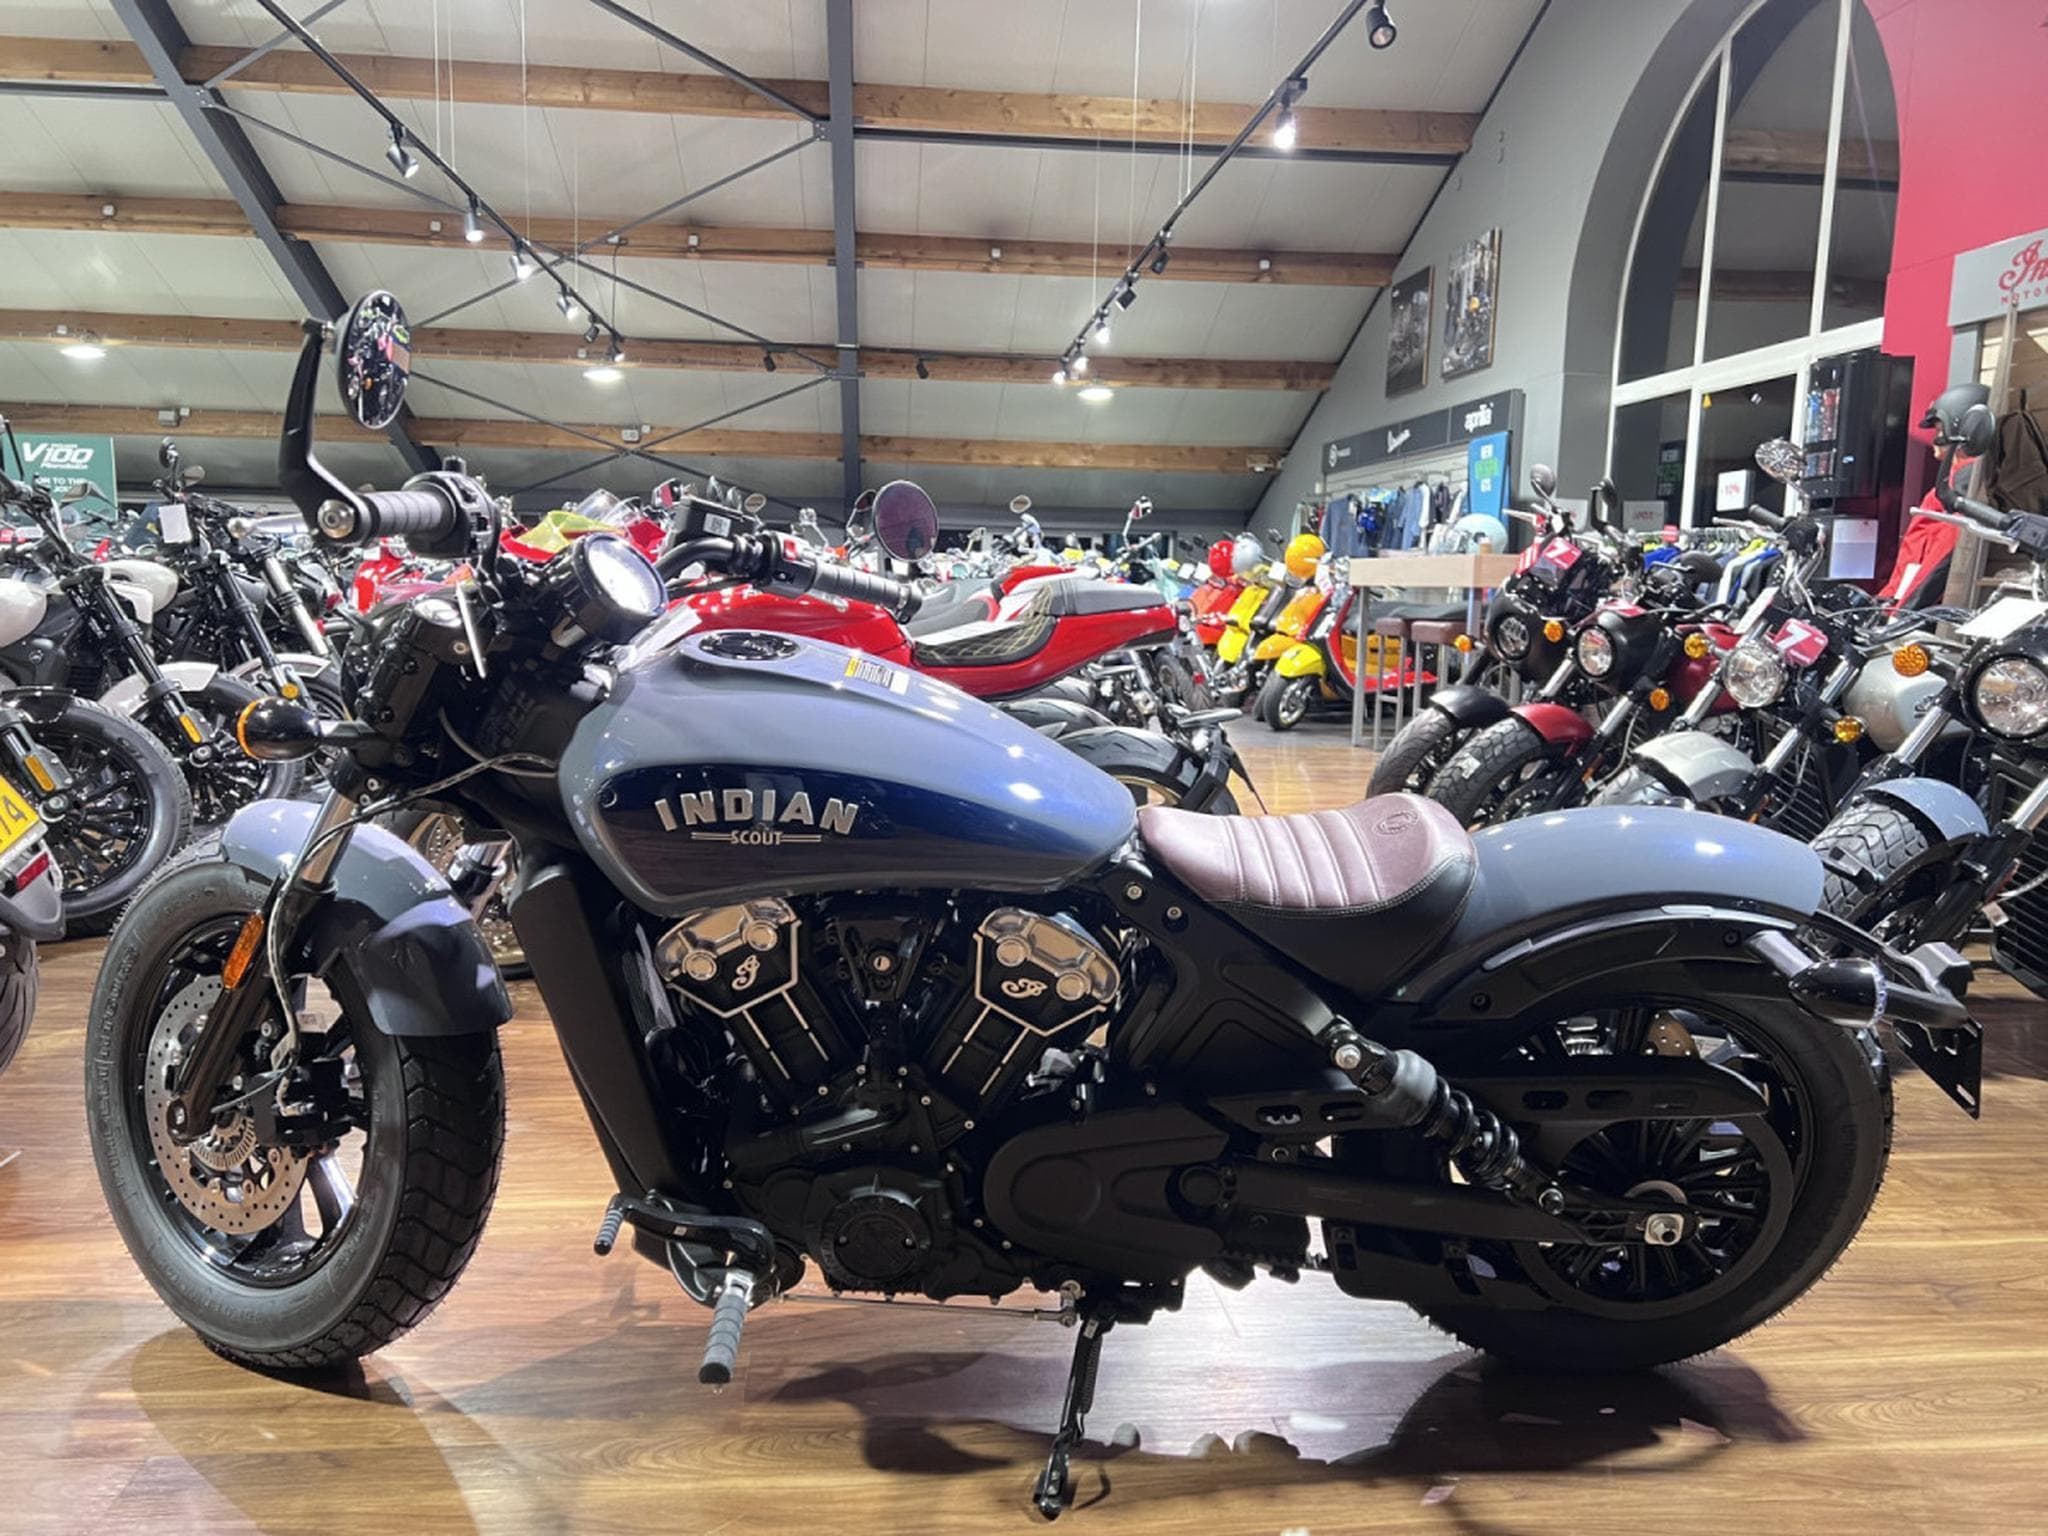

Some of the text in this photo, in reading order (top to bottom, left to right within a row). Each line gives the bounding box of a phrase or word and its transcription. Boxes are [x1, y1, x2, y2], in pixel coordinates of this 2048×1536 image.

[22, 442, 94, 462] V100
[1776, 621, 1812, 651] 7
[654, 787, 860, 835] INDIAN
[730, 830, 783, 846] SCOUT
